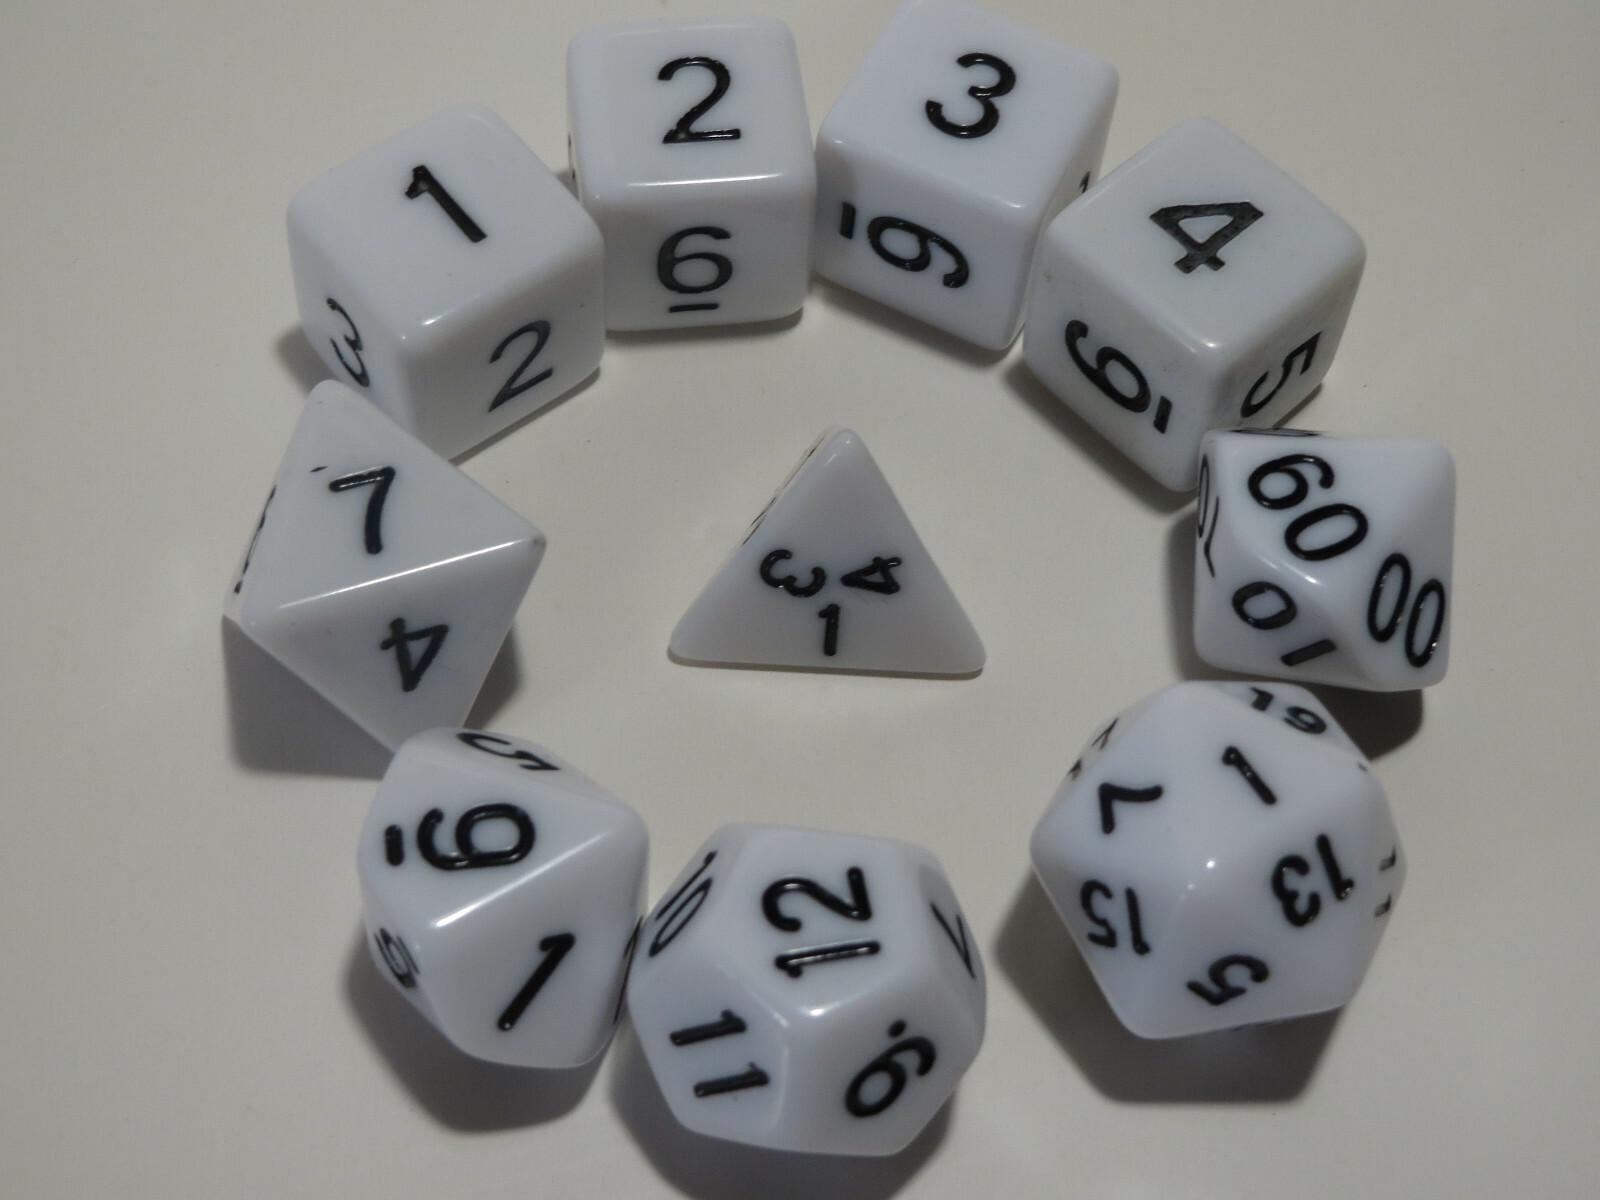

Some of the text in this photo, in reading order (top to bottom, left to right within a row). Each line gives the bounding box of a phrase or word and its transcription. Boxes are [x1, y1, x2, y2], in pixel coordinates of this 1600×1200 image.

[657, 56, 741, 144] 2
[925, 53, 1016, 139] 3
[405, 165, 487, 243] 1
[1149, 202, 1264, 274] 4
[657, 226, 733, 295] 6
[326, 297, 370, 388] 3
[489, 320, 553, 412] 2
[1240, 331, 1322, 418] 5
[329, 466, 397, 555] 7
[1247, 453, 1368, 562] 60
[759, 549, 827, 598] 3
[840, 556, 902, 595] 4
[1367, 553, 1446, 668] 00
[380, 618, 449, 692] 4
[818, 603, 841, 656] 1
[456, 732, 561, 771] 5
[1221, 746, 1277, 806] 1
[1098, 783, 1163, 834] 7
[1080, 880, 1150, 956] 15
[1271, 833, 1355, 928] 13
[761, 866, 882, 979] 12
[497, 932, 576, 1032] 1
[1186, 954, 1270, 1006] 5
[670, 1010, 770, 1098] 11
